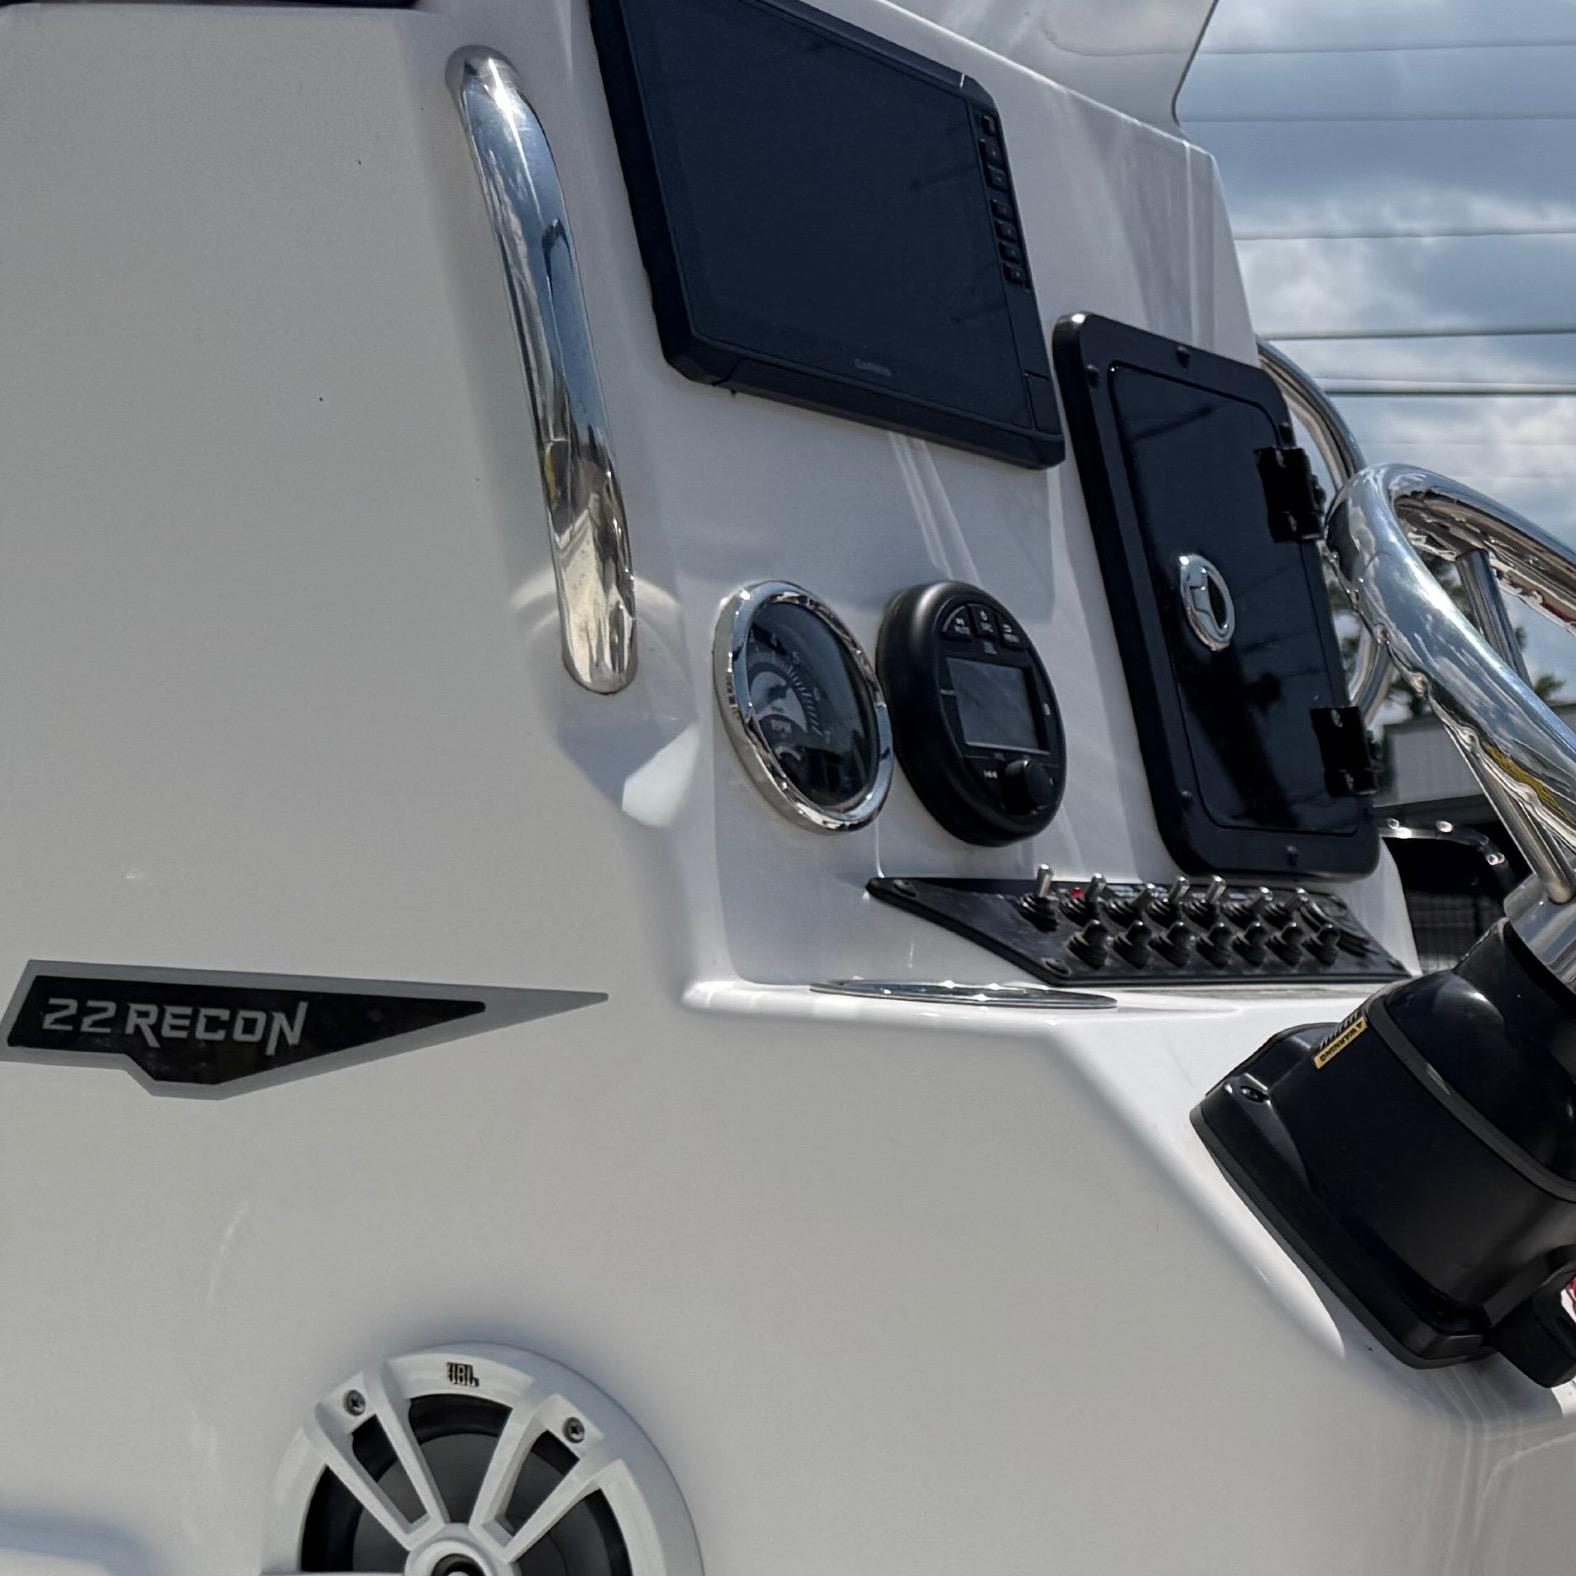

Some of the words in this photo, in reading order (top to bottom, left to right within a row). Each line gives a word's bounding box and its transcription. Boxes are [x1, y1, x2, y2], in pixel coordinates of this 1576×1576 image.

[40, 997, 119, 1034] 22
[125, 1000, 309, 1057] RECON
[446, 1361, 480, 1388] JBL
